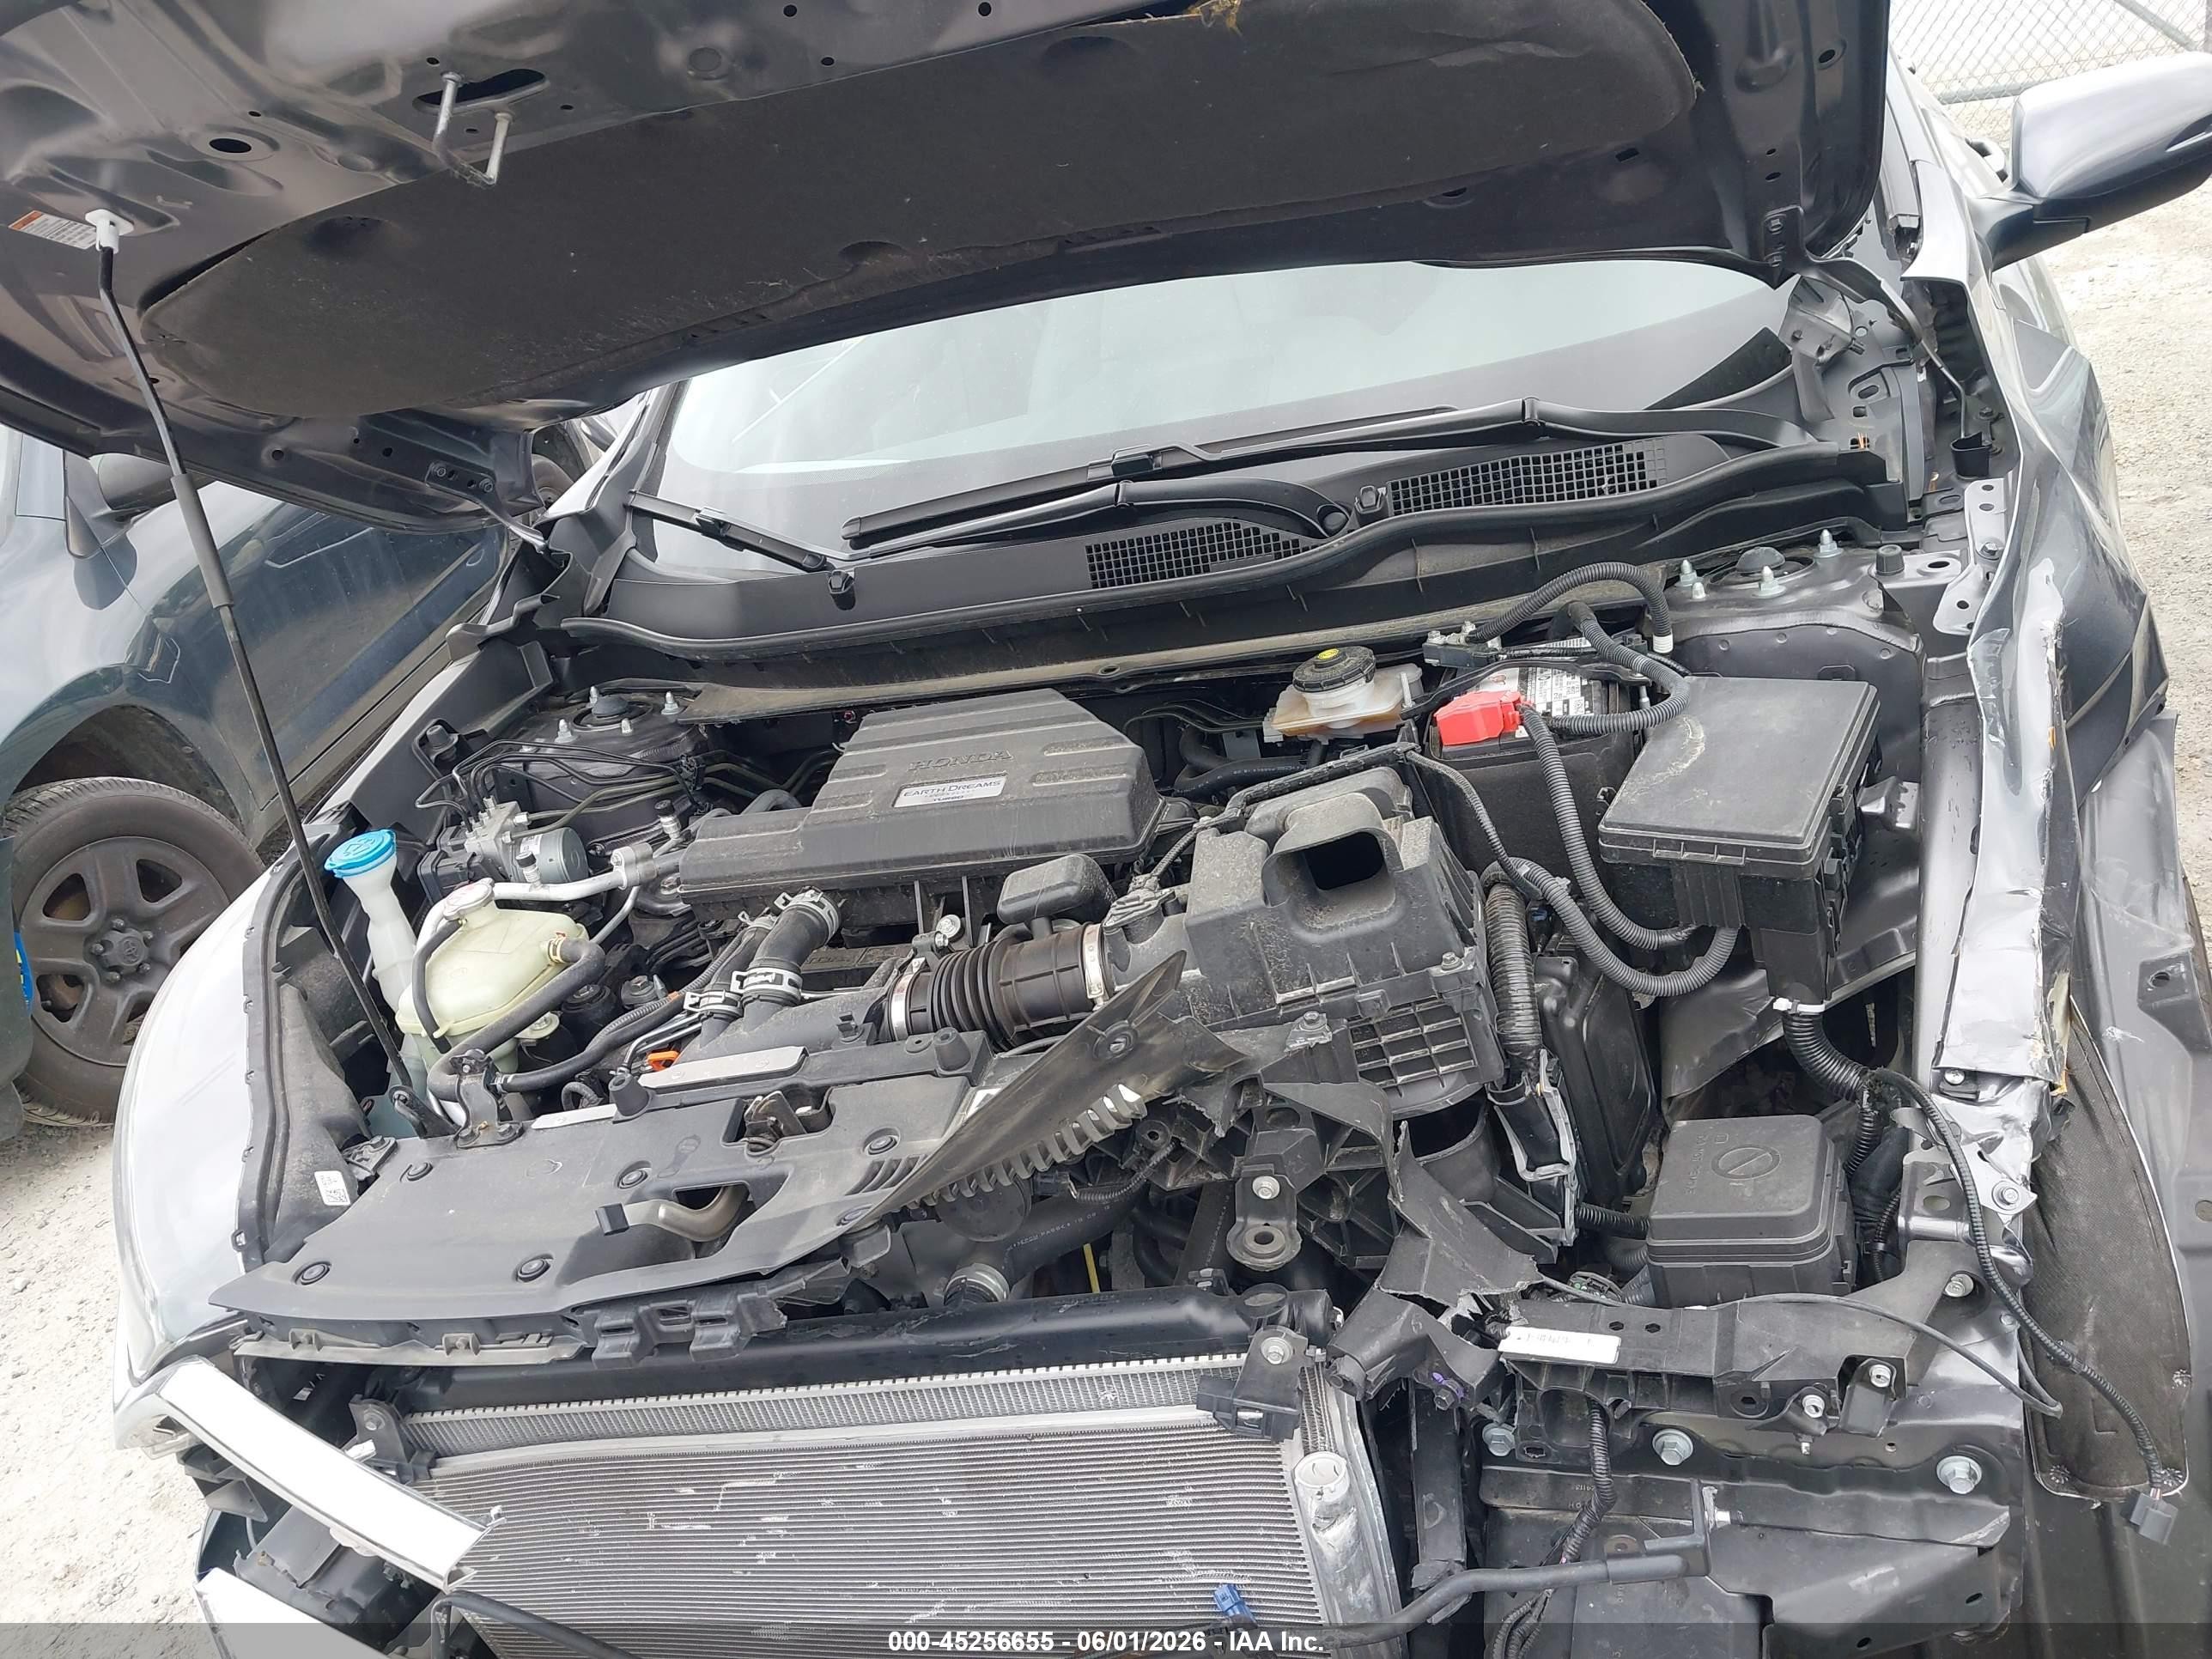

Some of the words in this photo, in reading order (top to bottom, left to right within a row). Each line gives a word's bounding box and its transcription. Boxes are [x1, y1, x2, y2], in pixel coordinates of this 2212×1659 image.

[907, 750, 1014, 772] HONDA
[903, 787, 945, 798] EARTH
[948, 780, 1001, 792] DREAMS
